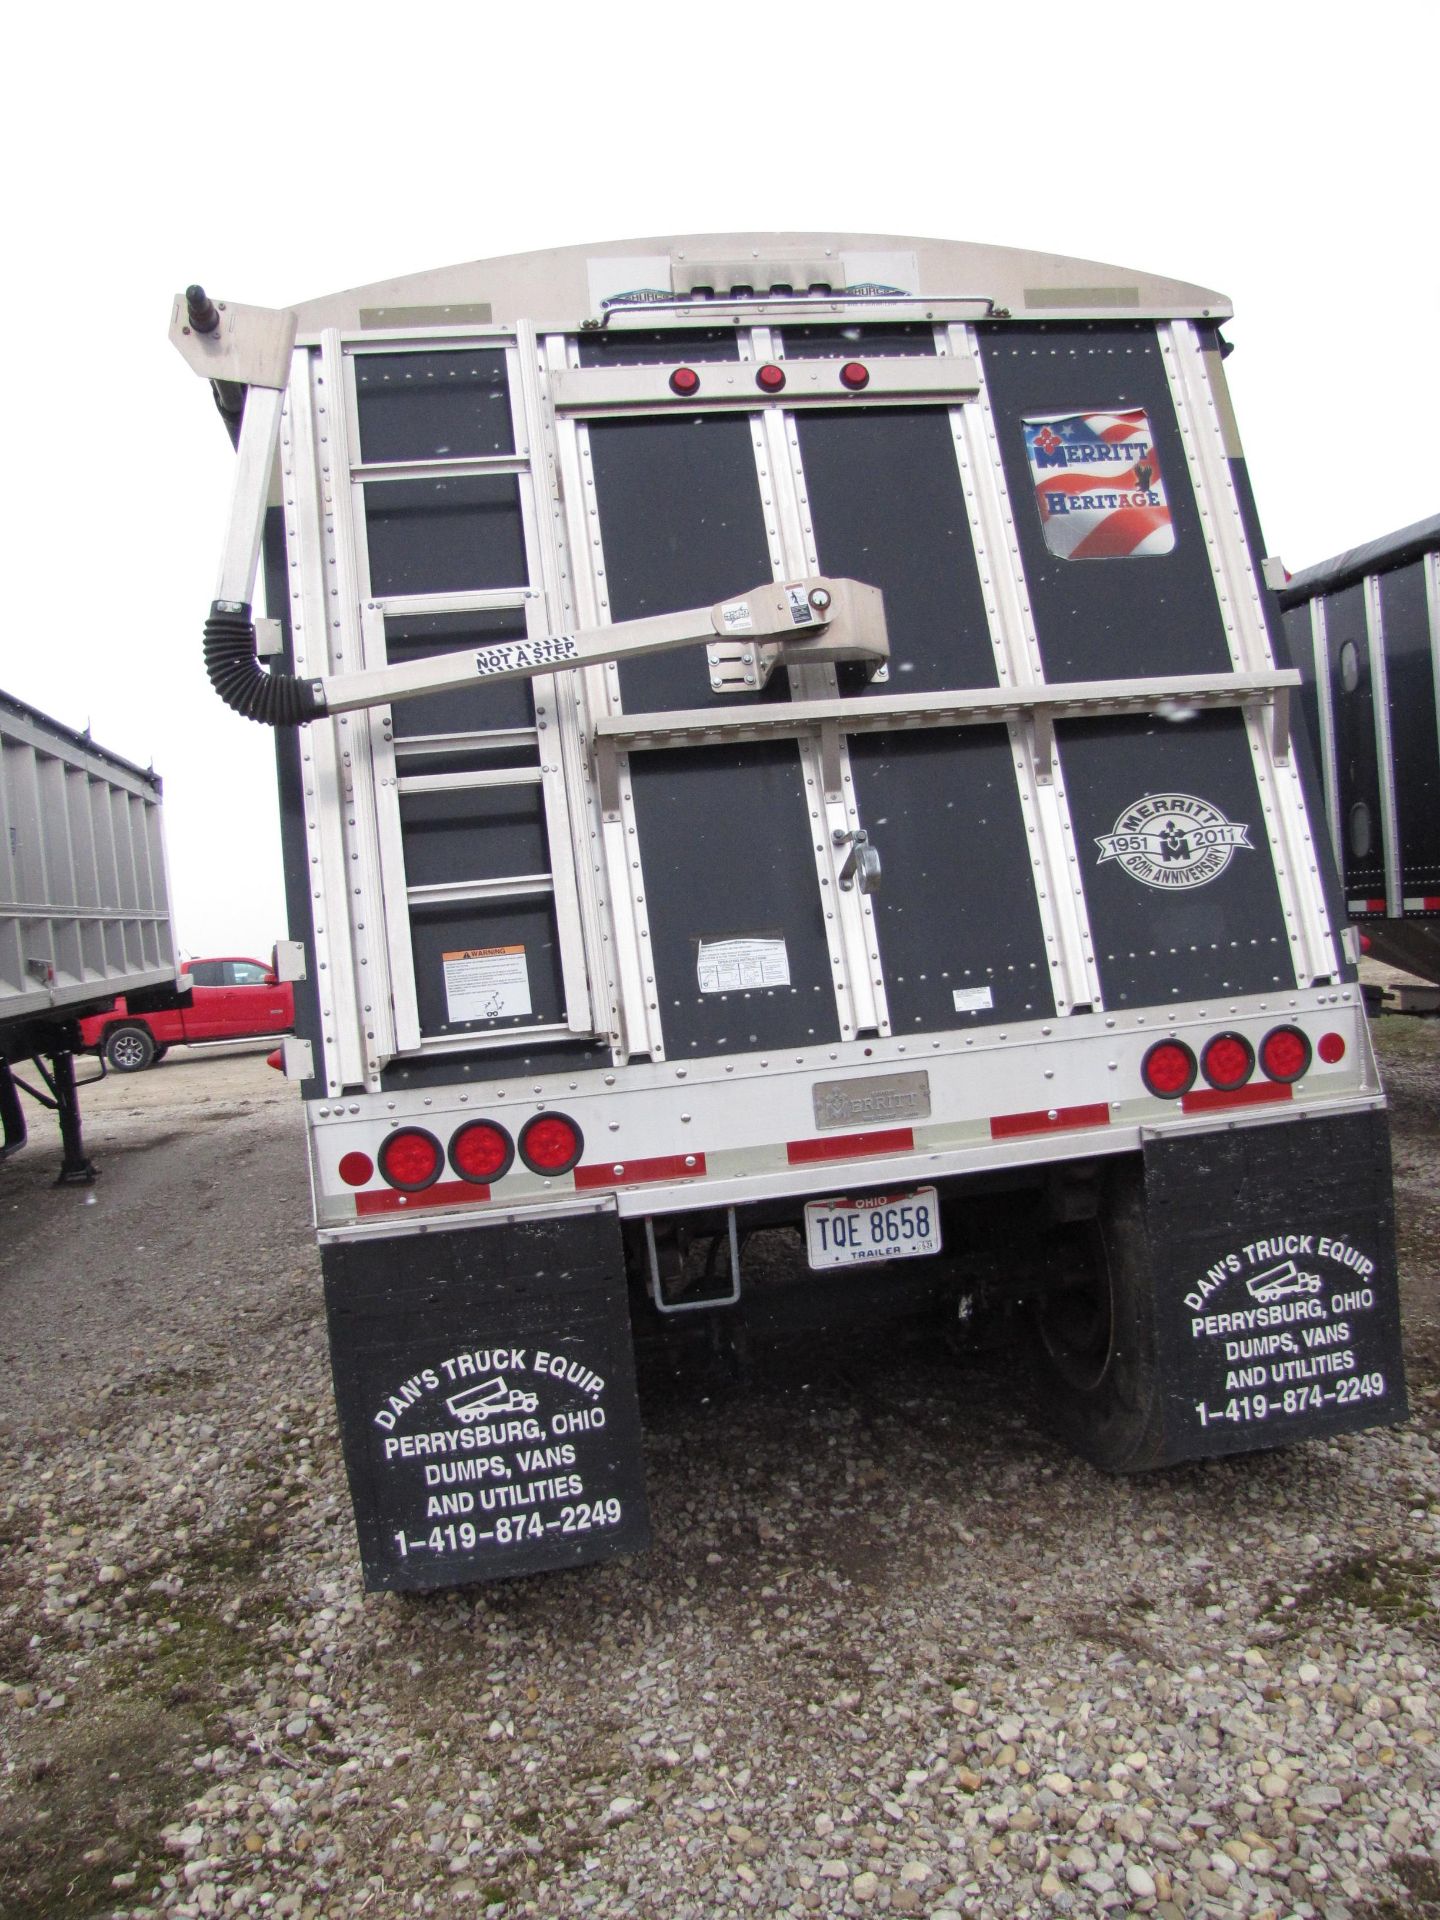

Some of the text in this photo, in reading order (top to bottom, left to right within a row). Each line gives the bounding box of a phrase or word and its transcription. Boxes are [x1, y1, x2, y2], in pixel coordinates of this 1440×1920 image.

[1033, 442, 1148, 469] MERRITT
[1045, 492, 1161, 516] HERITAGE
[476, 641, 575, 670] NOT A STEP
[1122, 799, 1220, 832] MERRITT
[1108, 837, 1148, 853] 1951
[1193, 828, 1236, 847] 2011
[1126, 847, 1228, 885] 60th ANNIVERSARY
[470, 948, 507, 958] WARNING
[826, 1092, 918, 1121] MERRITT
[855, 1196, 888, 1209] OHIO
[816, 1205, 930, 1251] TQE 8658
[851, 1246, 901, 1260] TRAILER
[1183, 1235, 1375, 1311] DAN'S TRUCK EQUIP.
[1192, 1288, 1374, 1337] PERRYSBURG, OHIO
[1225, 1322, 1350, 1360] DUMPS, VANS
[1225, 1350, 1356, 1390] AND UTILITIES
[374, 1348, 606, 1431] DAN'S TRUCK EQUIP.
[1195, 1373, 1385, 1426] 1-419-874-2249
[384, 1407, 606, 1459] PERRYSBURG, OHIO
[424, 1444, 576, 1486] DUMPS, VANS
[427, 1474, 584, 1517] AND UTILITIES
[394, 1497, 622, 1556] 1-419-874-2249
